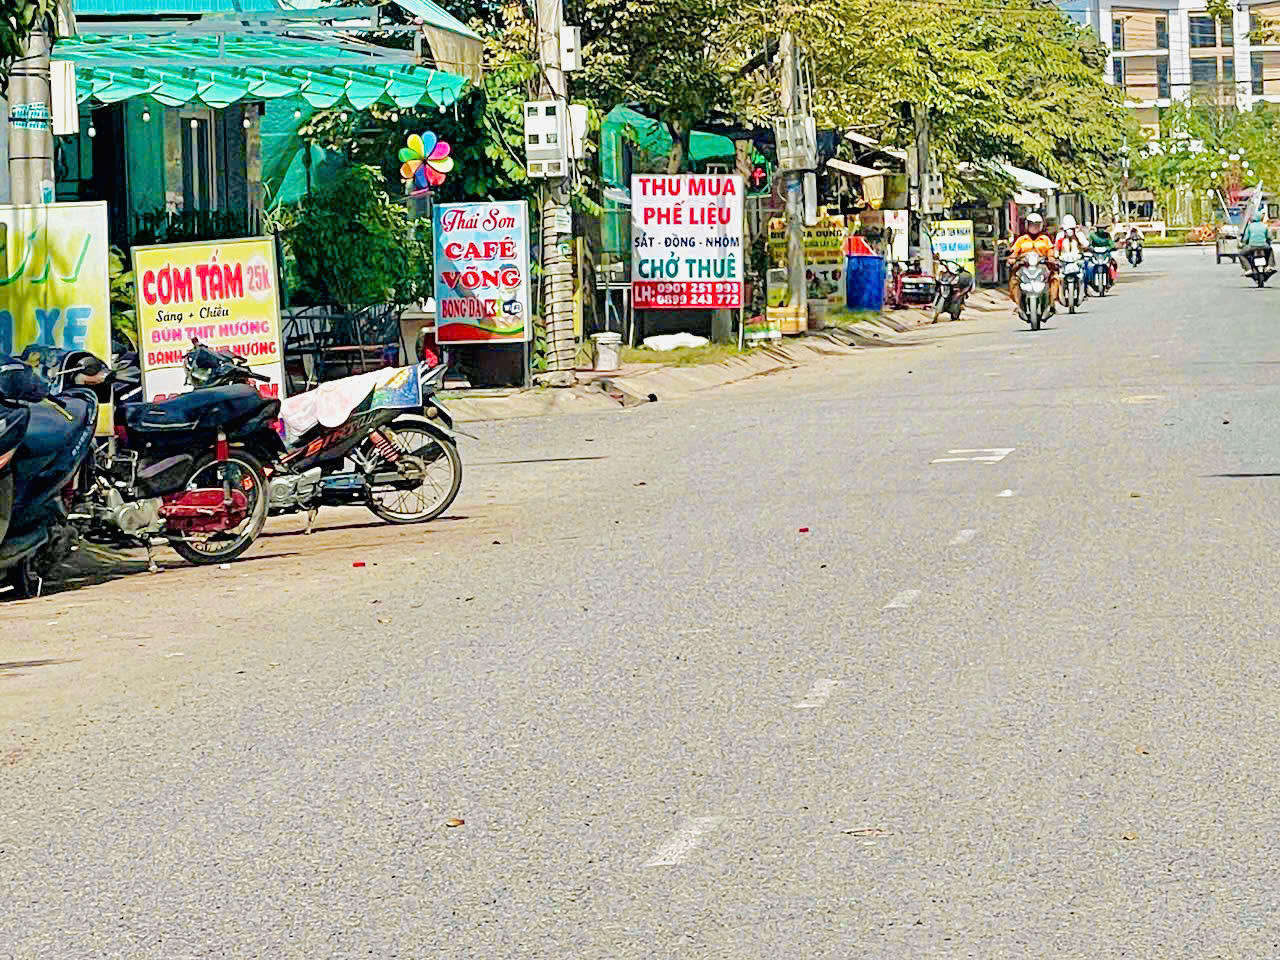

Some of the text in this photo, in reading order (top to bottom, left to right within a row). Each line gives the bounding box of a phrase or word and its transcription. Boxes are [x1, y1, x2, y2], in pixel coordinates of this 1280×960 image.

[639, 178, 736, 196] THU MUA
[643, 200, 731, 230] PHẾ LIỆU
[685, 252, 737, 278] THUÊ
[143, 263, 193, 305] CƠM
